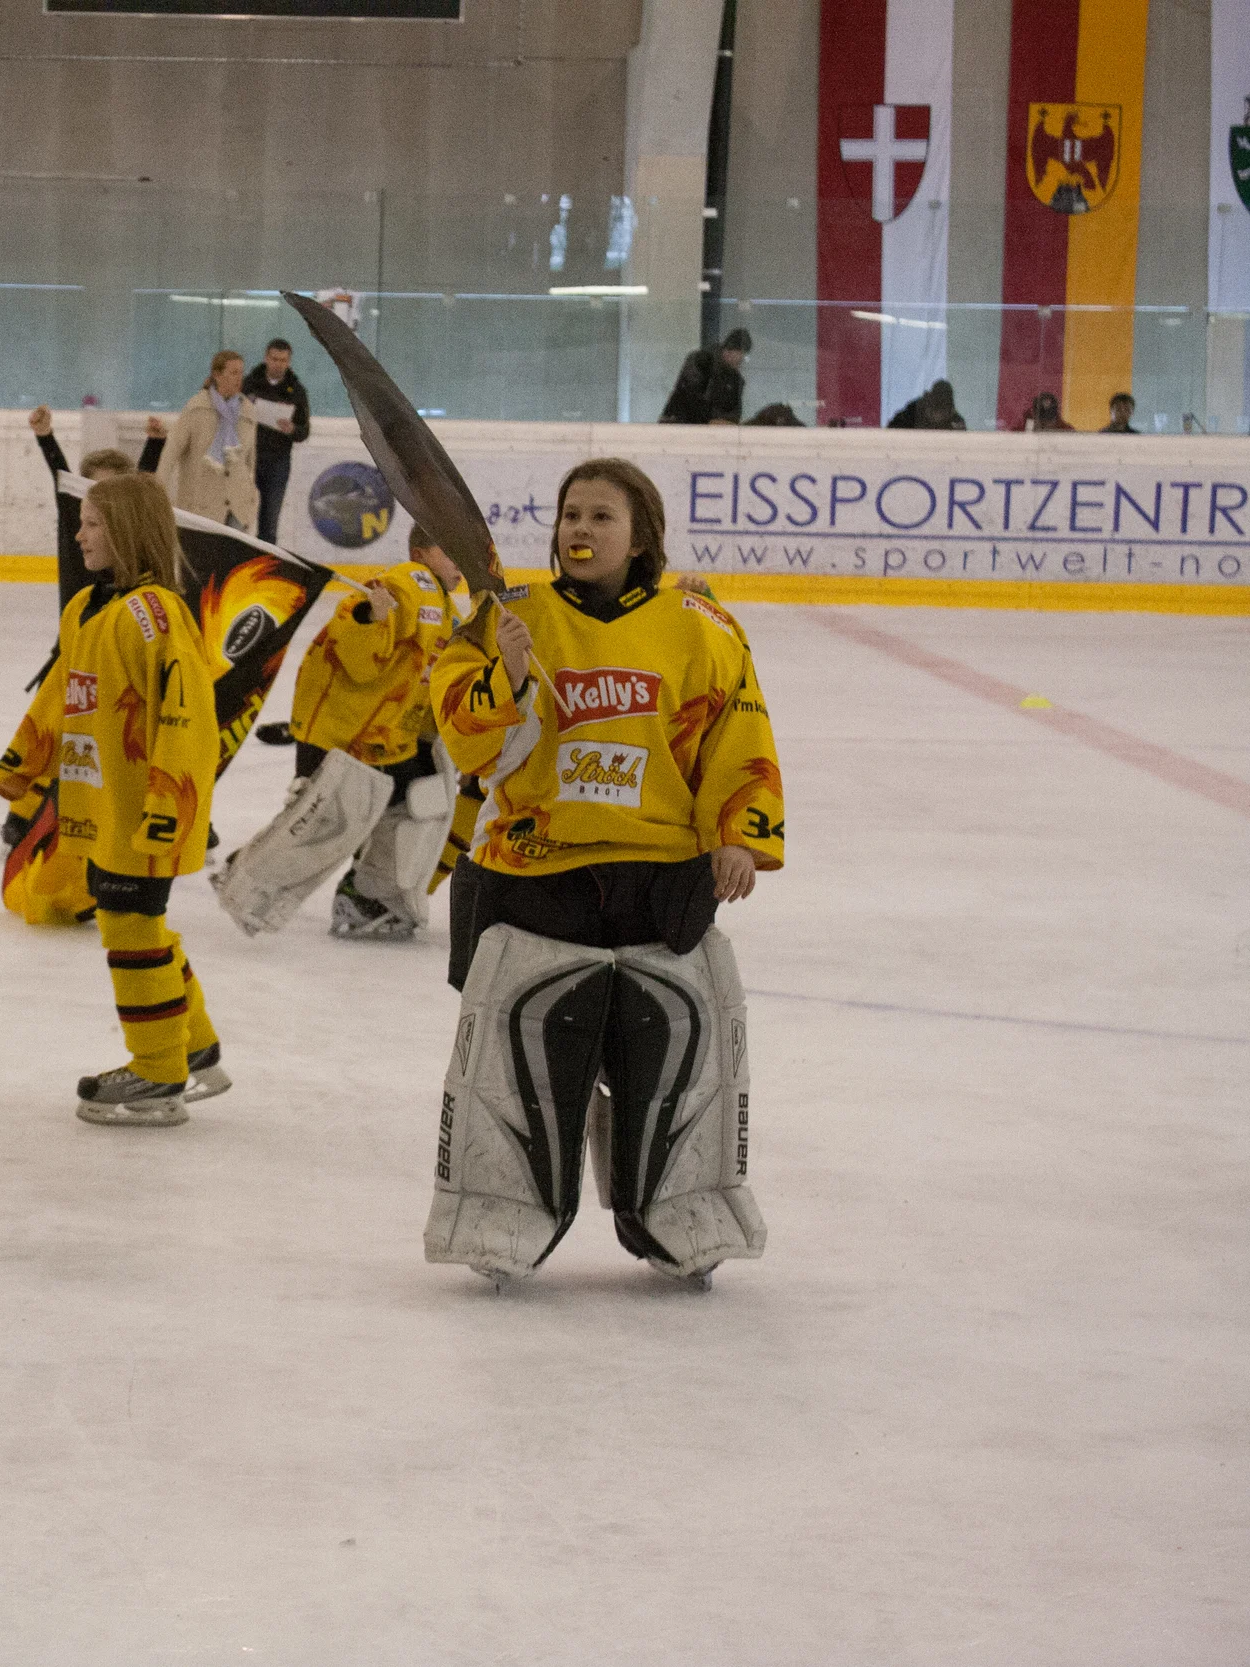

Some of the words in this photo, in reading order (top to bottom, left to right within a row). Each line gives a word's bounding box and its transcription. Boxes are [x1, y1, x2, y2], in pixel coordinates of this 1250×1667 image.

[689, 472, 1246, 536] EISSPORTZENTR
[691, 543, 1242, 580] www.sportwelt-no
[128, 597, 155, 639] RICOH
[564, 675, 651, 713] Kelly's
[562, 747, 638, 789] Ströck
[579, 785, 622, 798] BROT
